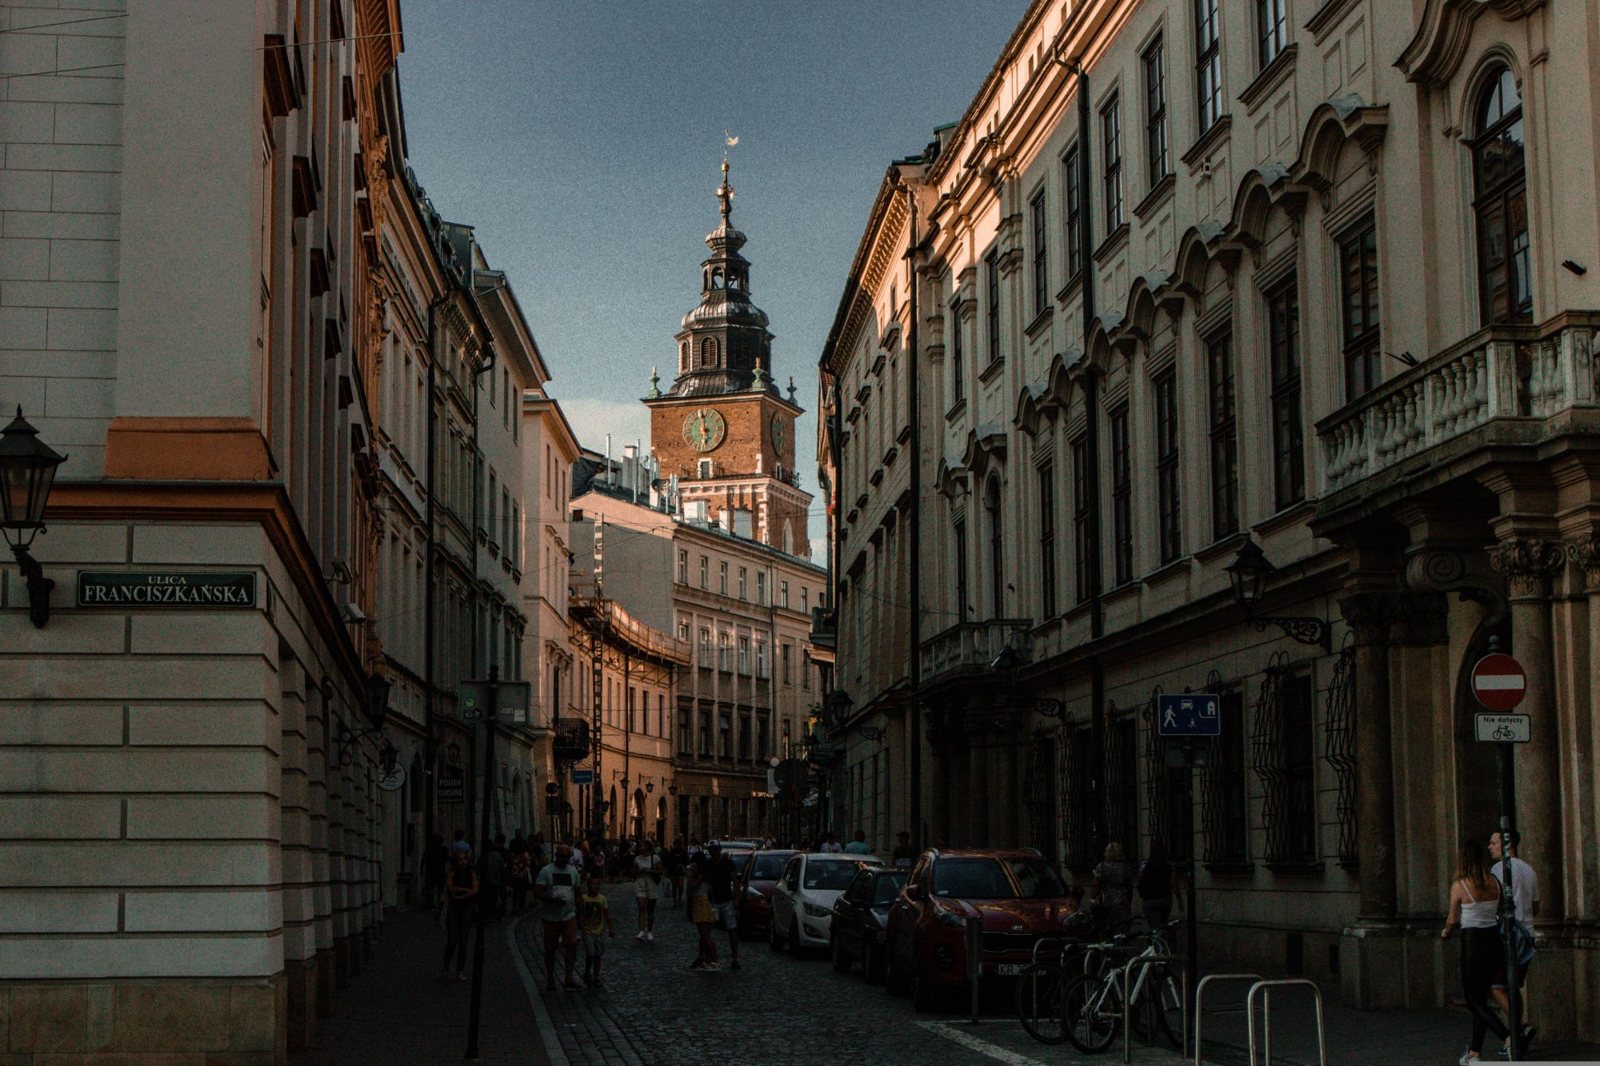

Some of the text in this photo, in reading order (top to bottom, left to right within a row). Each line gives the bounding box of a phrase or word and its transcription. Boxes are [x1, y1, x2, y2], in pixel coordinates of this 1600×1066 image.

[147, 576, 187, 584] ULICA
[84, 584, 249, 602] FRANCISZKAŃSKA
[439, 778, 461, 786] POLISH
